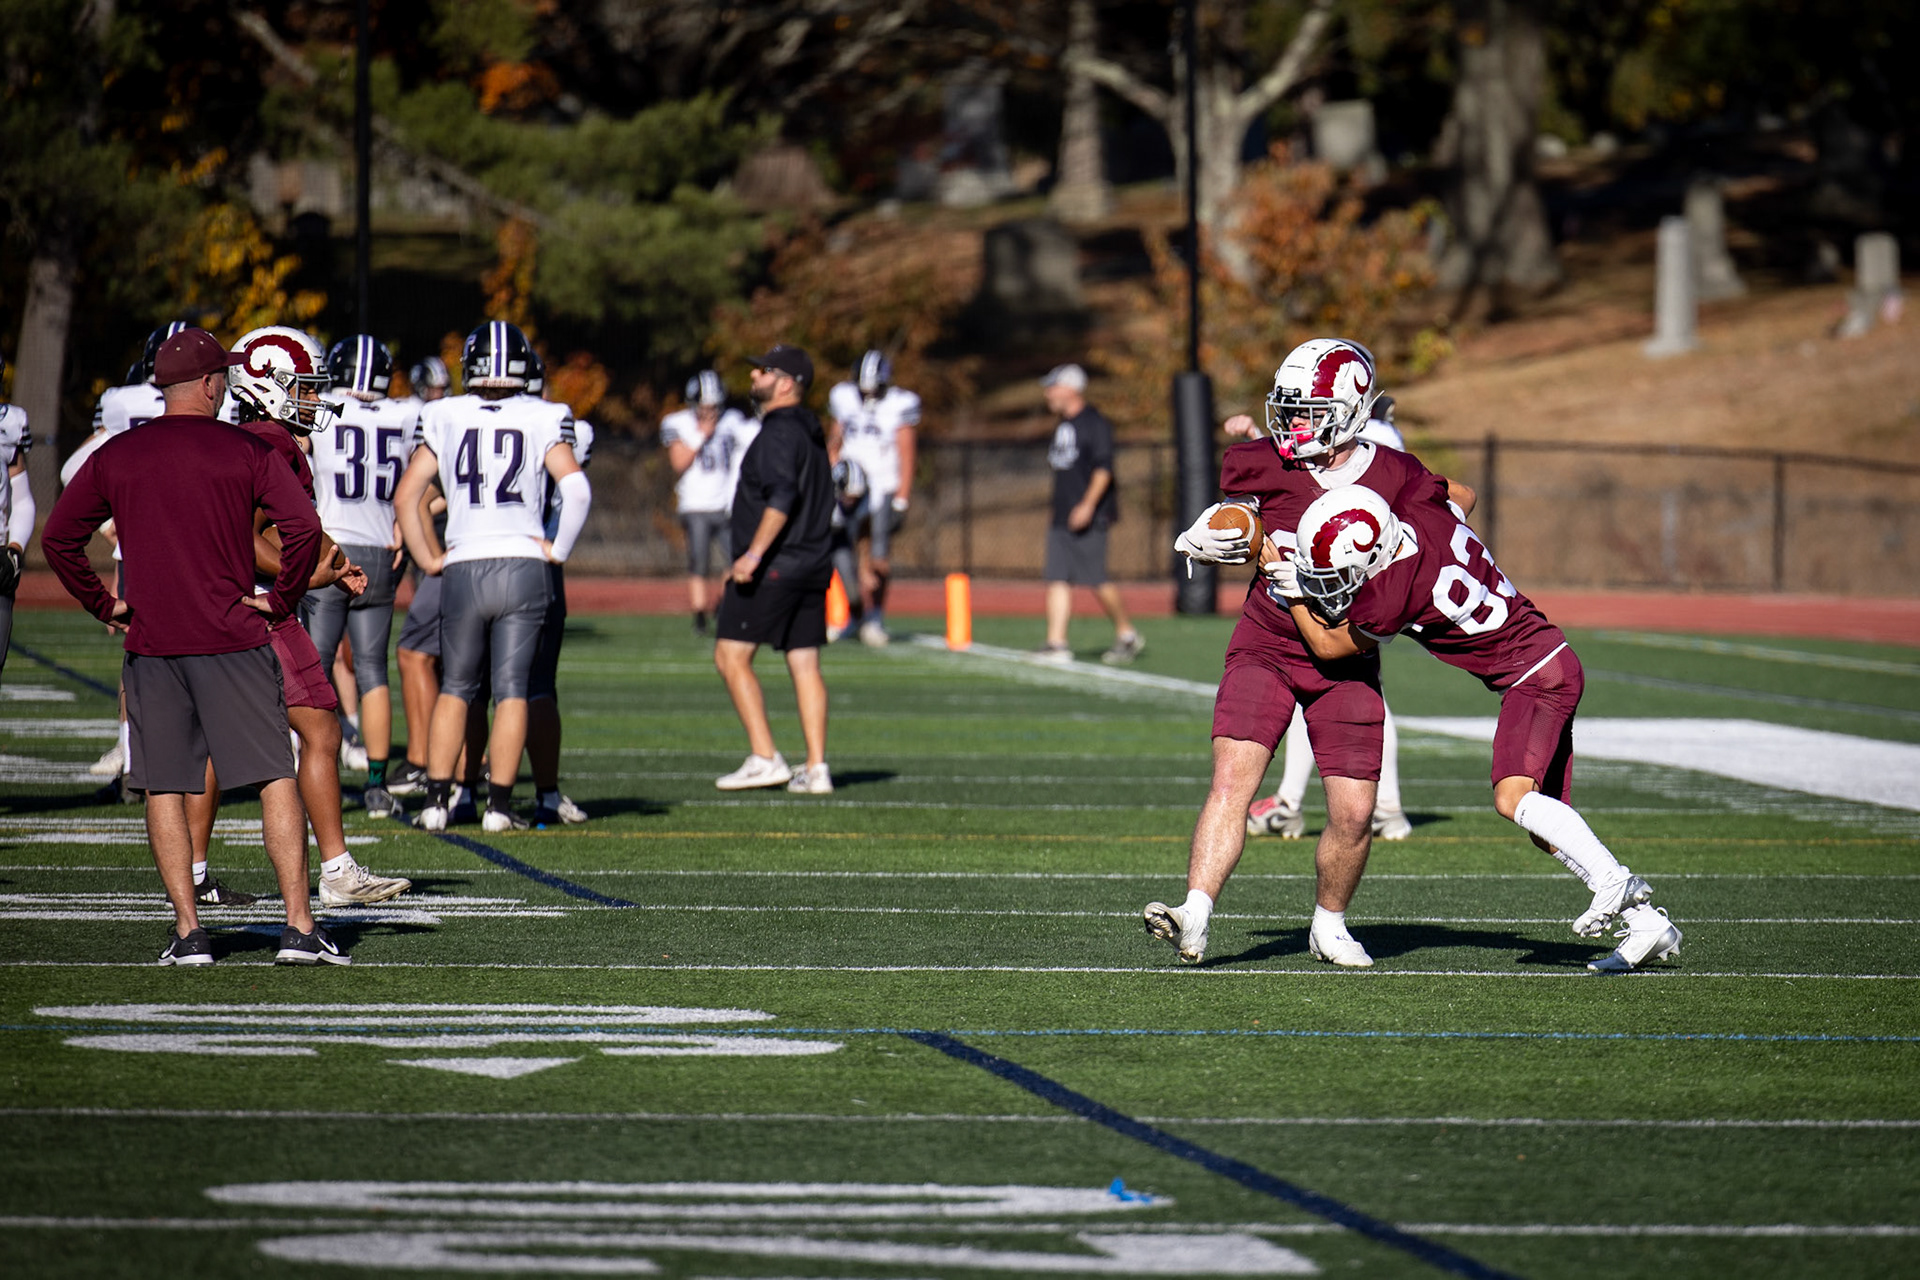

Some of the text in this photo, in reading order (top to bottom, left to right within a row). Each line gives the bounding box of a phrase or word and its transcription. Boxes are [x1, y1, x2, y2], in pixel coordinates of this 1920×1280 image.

[335, 425, 404, 504] 35
[455, 428, 526, 509] 42
[1432, 523, 1517, 635] 83
[32, 1003, 844, 1056] 30
[204, 1180, 1320, 1276] 20
